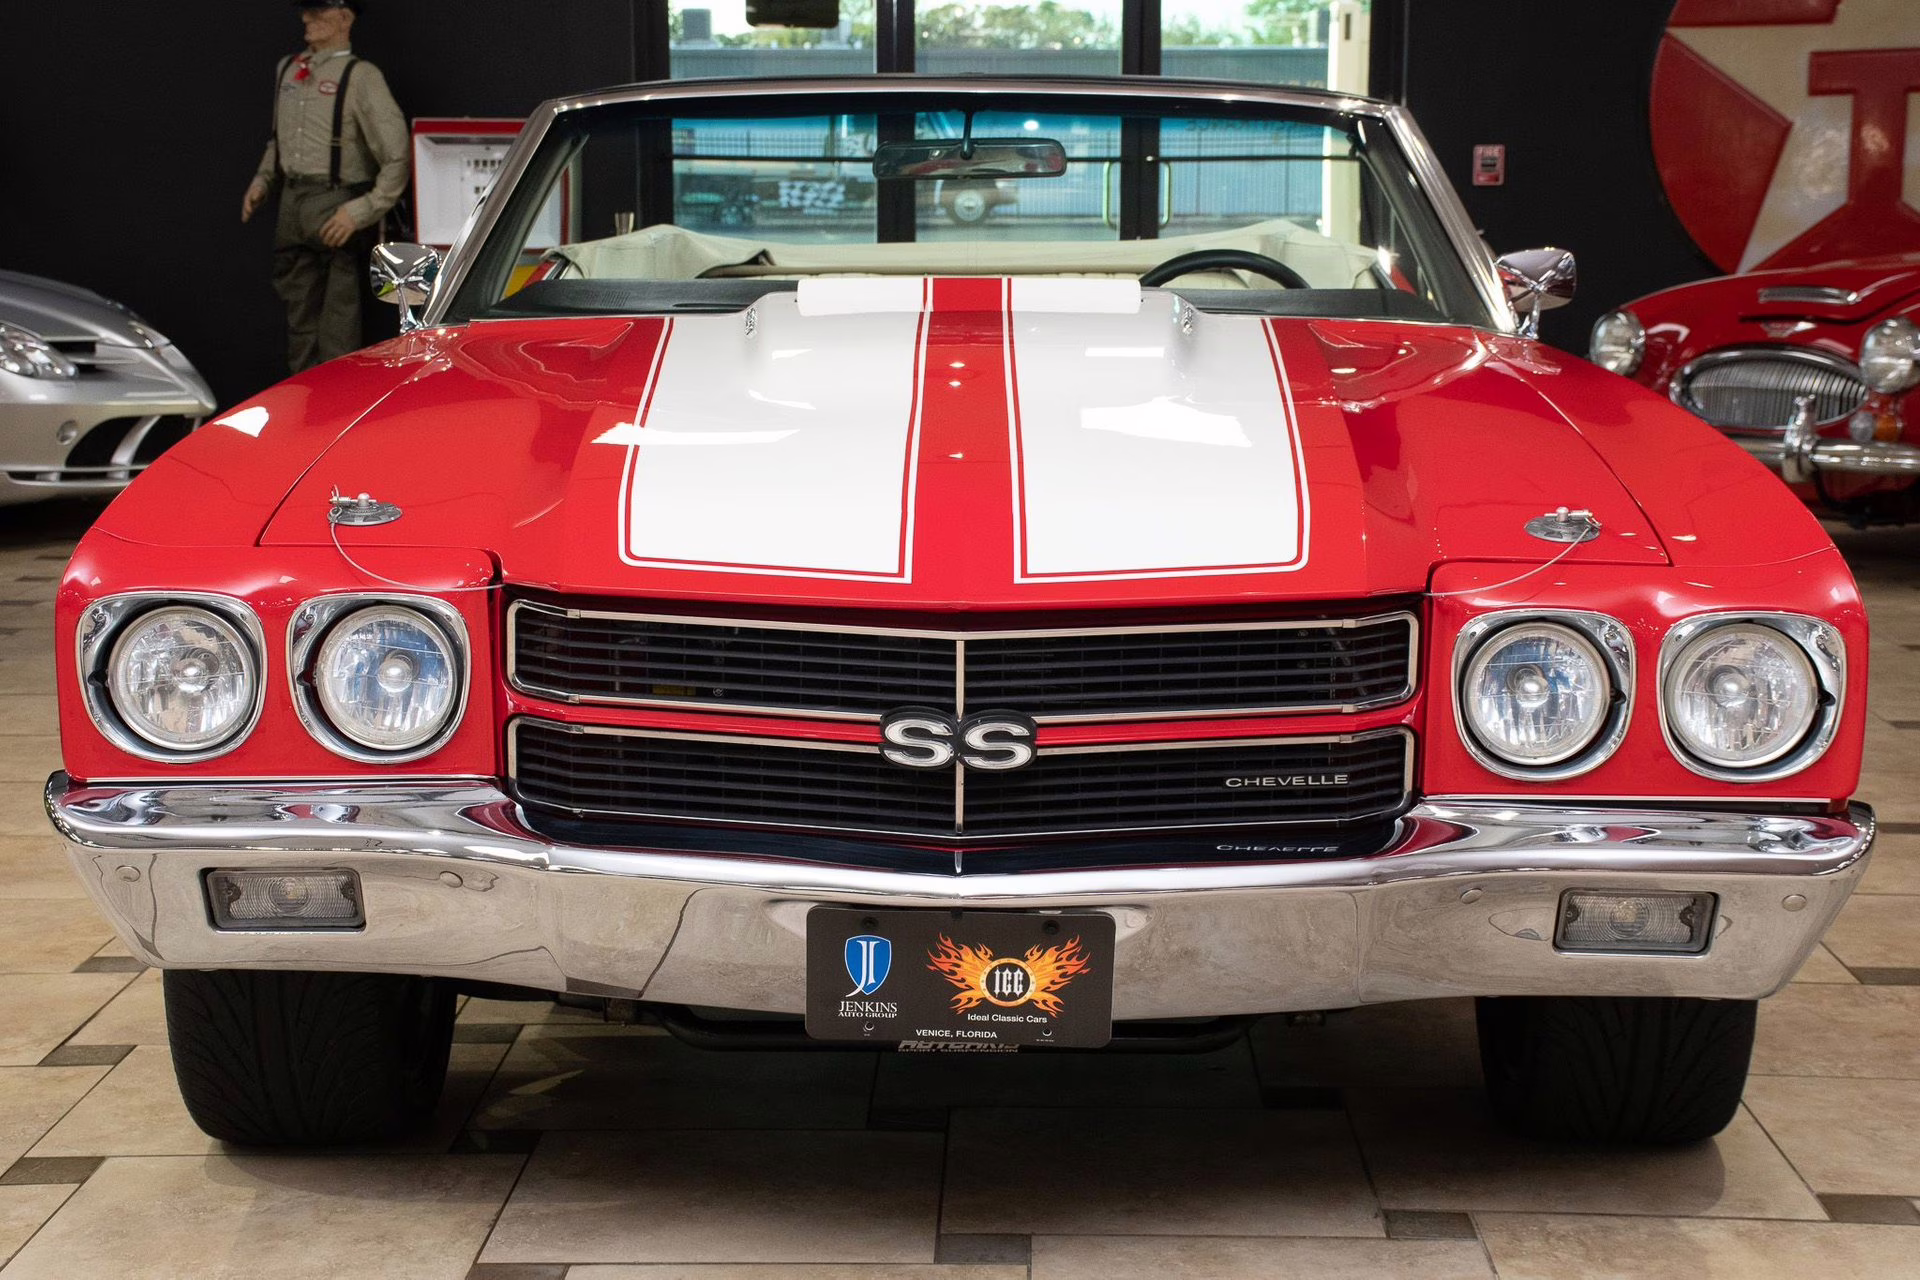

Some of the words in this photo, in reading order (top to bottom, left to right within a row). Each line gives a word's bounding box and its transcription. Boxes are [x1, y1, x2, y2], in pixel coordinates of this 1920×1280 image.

[883, 718, 1032, 769] SS
[1225, 774, 1348, 788] CHEVELLE
[839, 1001, 898, 1012] JENKINS
[967, 1013, 990, 1022] Ideal
[991, 1014, 1024, 1023] Classic
[1026, 1015, 1048, 1024] Cars
[915, 1029, 954, 1038] VENICE,
[956, 1030, 998, 1039] FLORIDA
